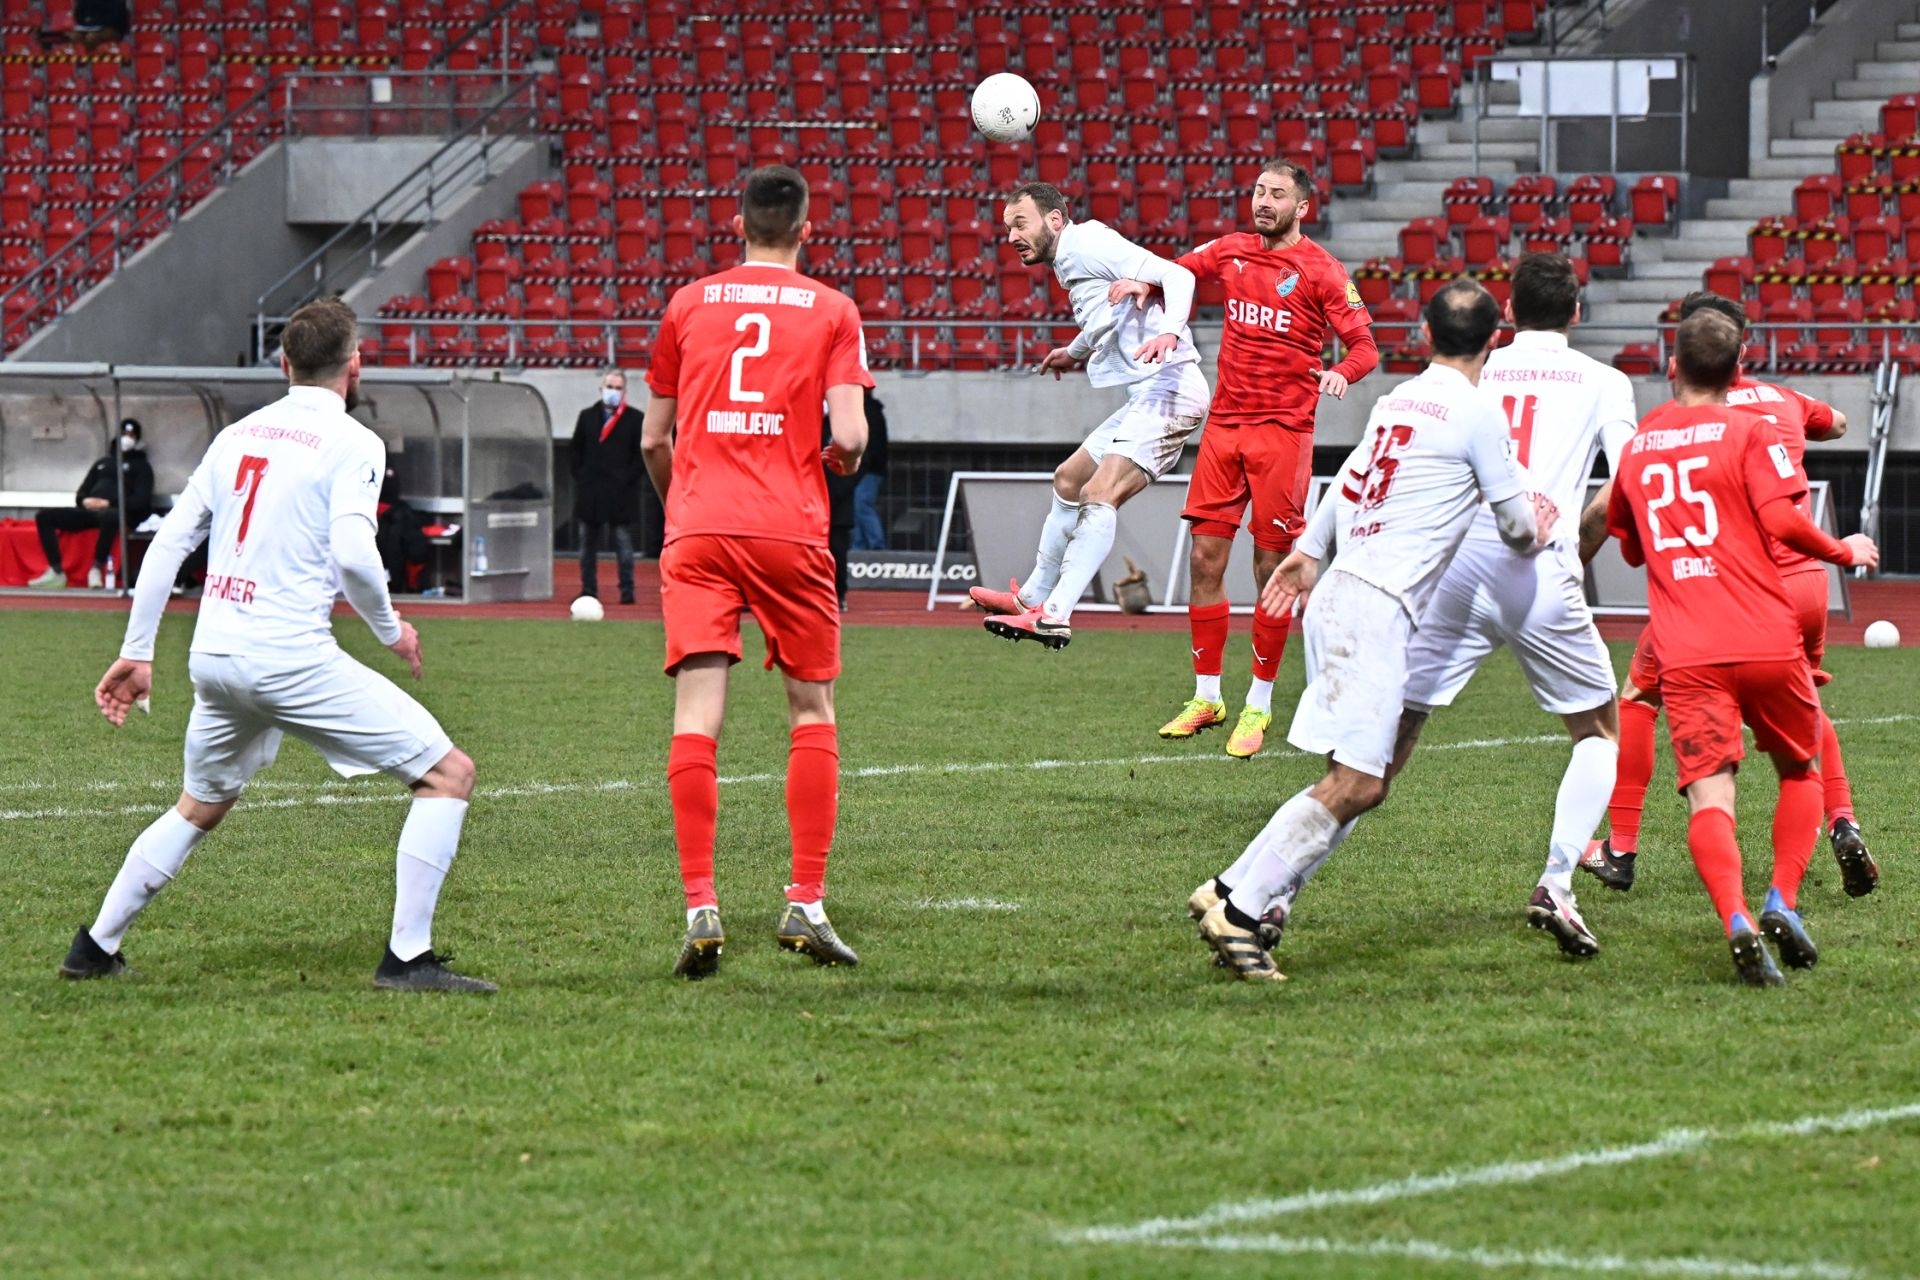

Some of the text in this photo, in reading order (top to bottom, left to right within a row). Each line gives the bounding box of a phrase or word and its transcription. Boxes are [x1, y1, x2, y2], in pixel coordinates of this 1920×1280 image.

[703, 283, 723, 303] TSV
[723, 283, 779, 304] STEINBACH
[1227, 298, 1292, 333] SIBRE
[729, 312, 771, 402] 2
[1493, 370, 1538, 382] HESSEN
[1540, 370, 1584, 384] KASSEL
[706, 410, 785, 435] MIHALJEVIC
[1502, 394, 1540, 472] 4
[233, 454, 269, 558] 7
[1640, 455, 1719, 552] 25
